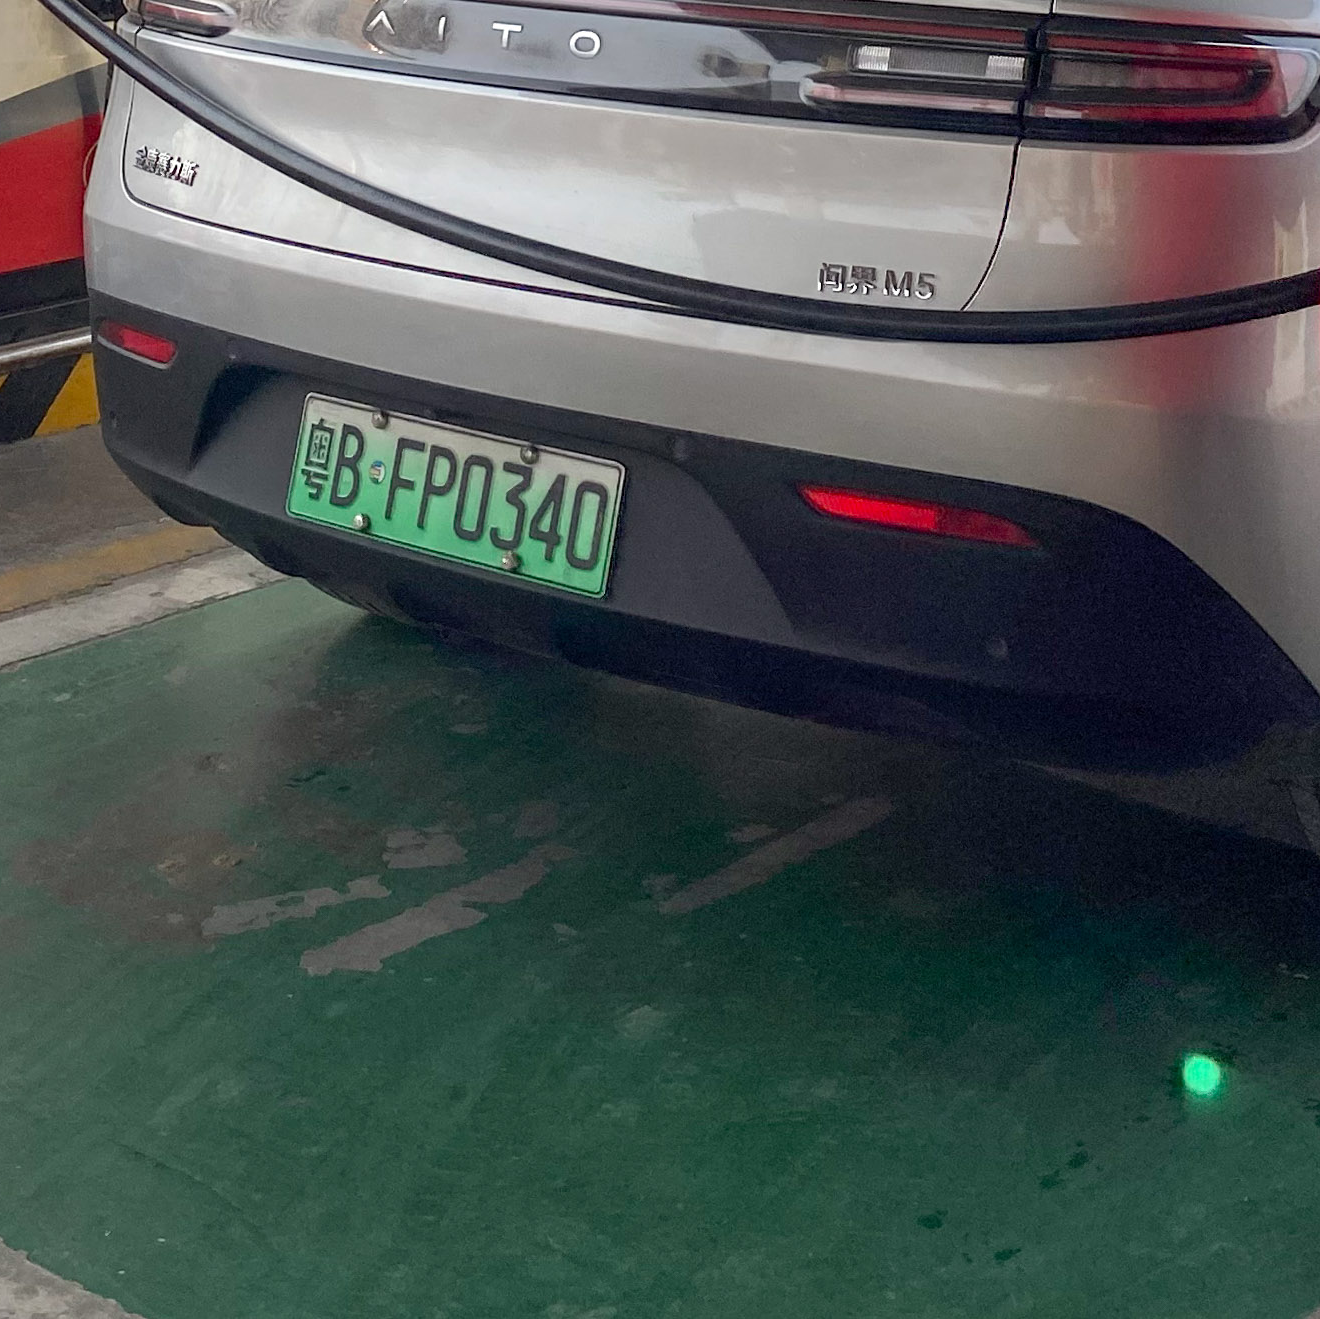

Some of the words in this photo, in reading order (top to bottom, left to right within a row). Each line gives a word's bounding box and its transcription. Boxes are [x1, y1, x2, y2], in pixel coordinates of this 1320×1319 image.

[366, 10, 602, 59] AITO
[301, 417, 365, 507] 粤B
[385, 437, 609, 571] FP0340
